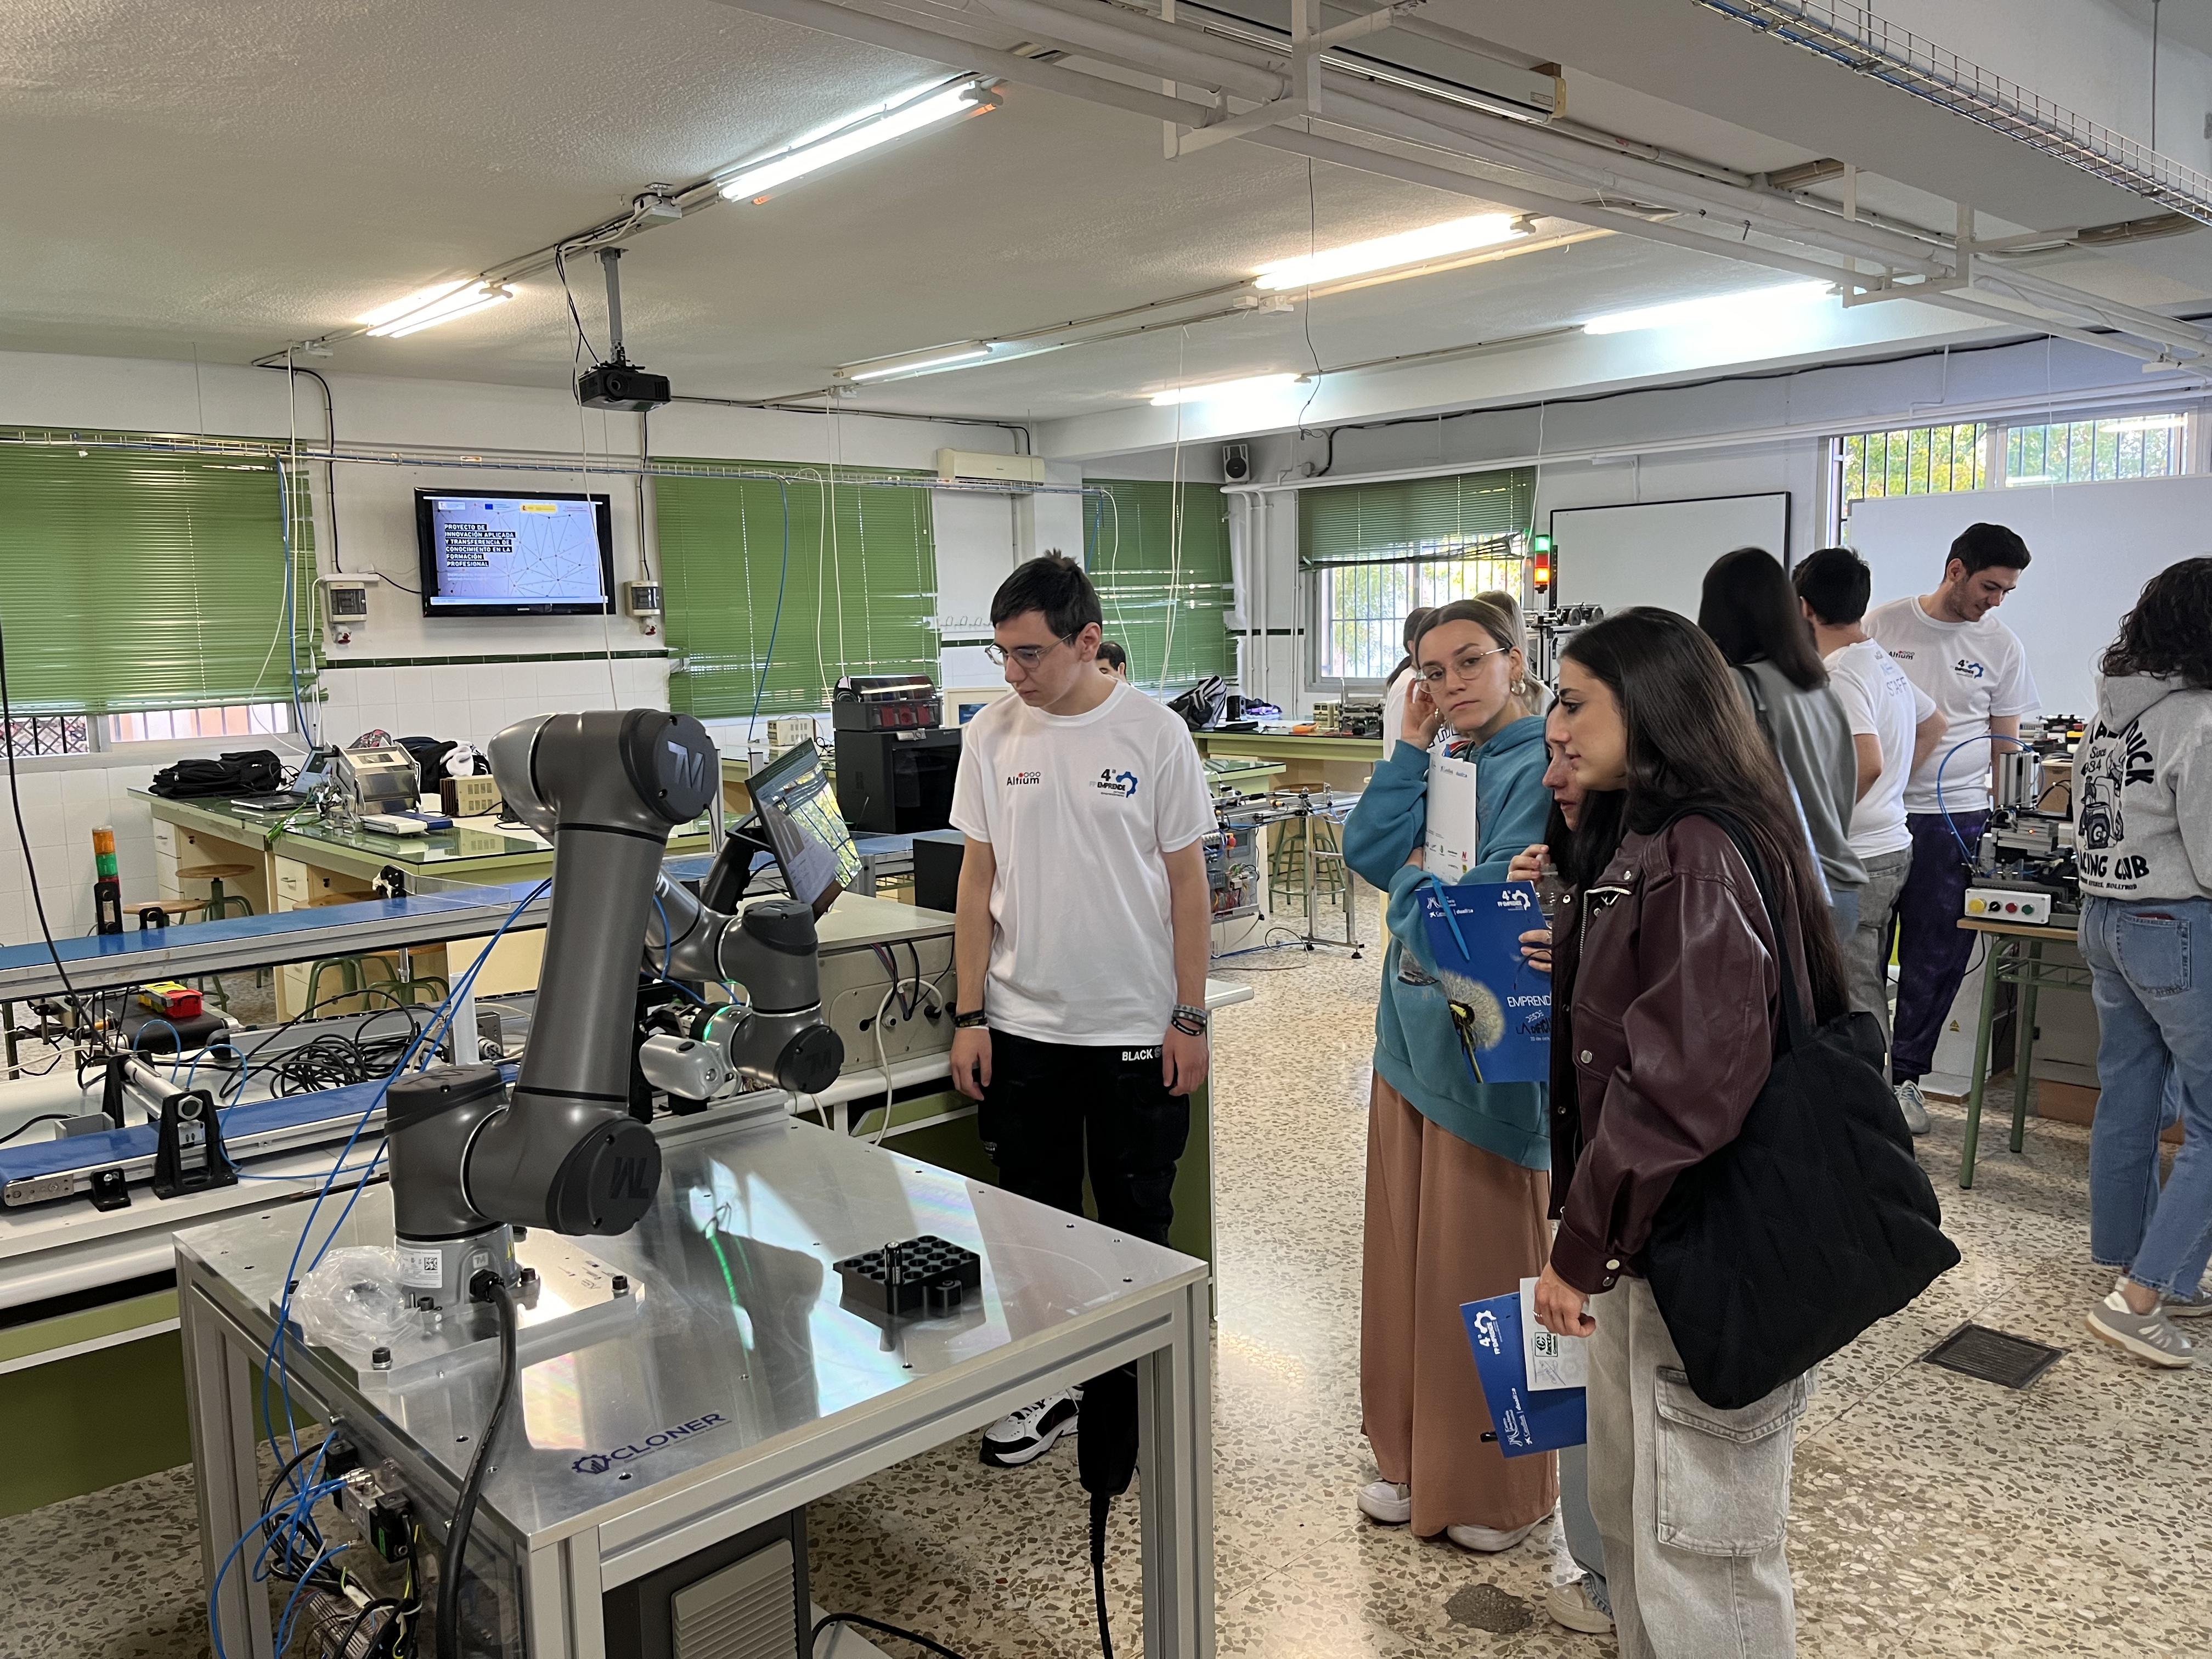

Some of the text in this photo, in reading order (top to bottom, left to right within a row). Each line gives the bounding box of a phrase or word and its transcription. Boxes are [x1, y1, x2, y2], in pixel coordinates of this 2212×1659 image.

[1887, 676, 1907, 696] STAFF
[2090, 746, 2107, 759] Since
[1006, 774, 1040, 786] Altium
[1097, 782, 1126, 791] EMPRENDE
[1507, 995, 1551, 1007] EMPREND
[1122, 1048, 1153, 1061] BLACK
[610, 1413, 726, 1459] CLONER
